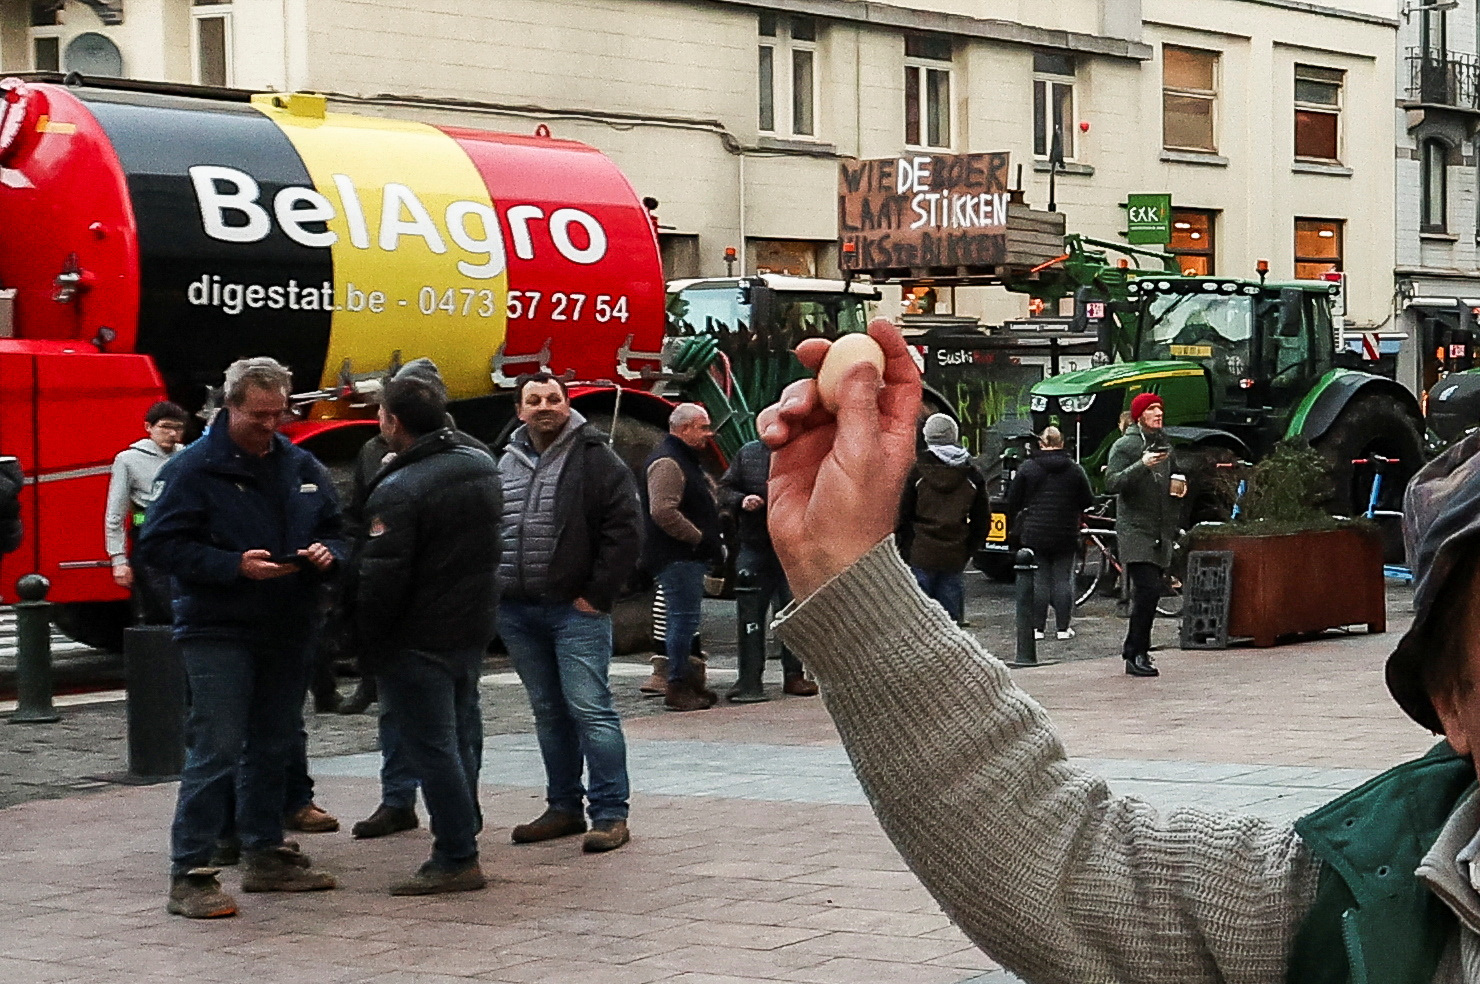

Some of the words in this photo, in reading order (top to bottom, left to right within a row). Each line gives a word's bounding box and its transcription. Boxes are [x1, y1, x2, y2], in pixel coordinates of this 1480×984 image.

[840, 160, 894, 193] WIE
[898, 157, 932, 194] DE
[188, 165, 608, 280] BelAgro
[841, 195, 907, 231] LAAT
[188, 275, 386, 314] digestat.be
[418, 285, 496, 317] 0473
[506, 290, 541, 320] 57
[551, 292, 587, 322] 27
[595, 294, 630, 324] 54
[937, 349, 973, 366] Sushi
